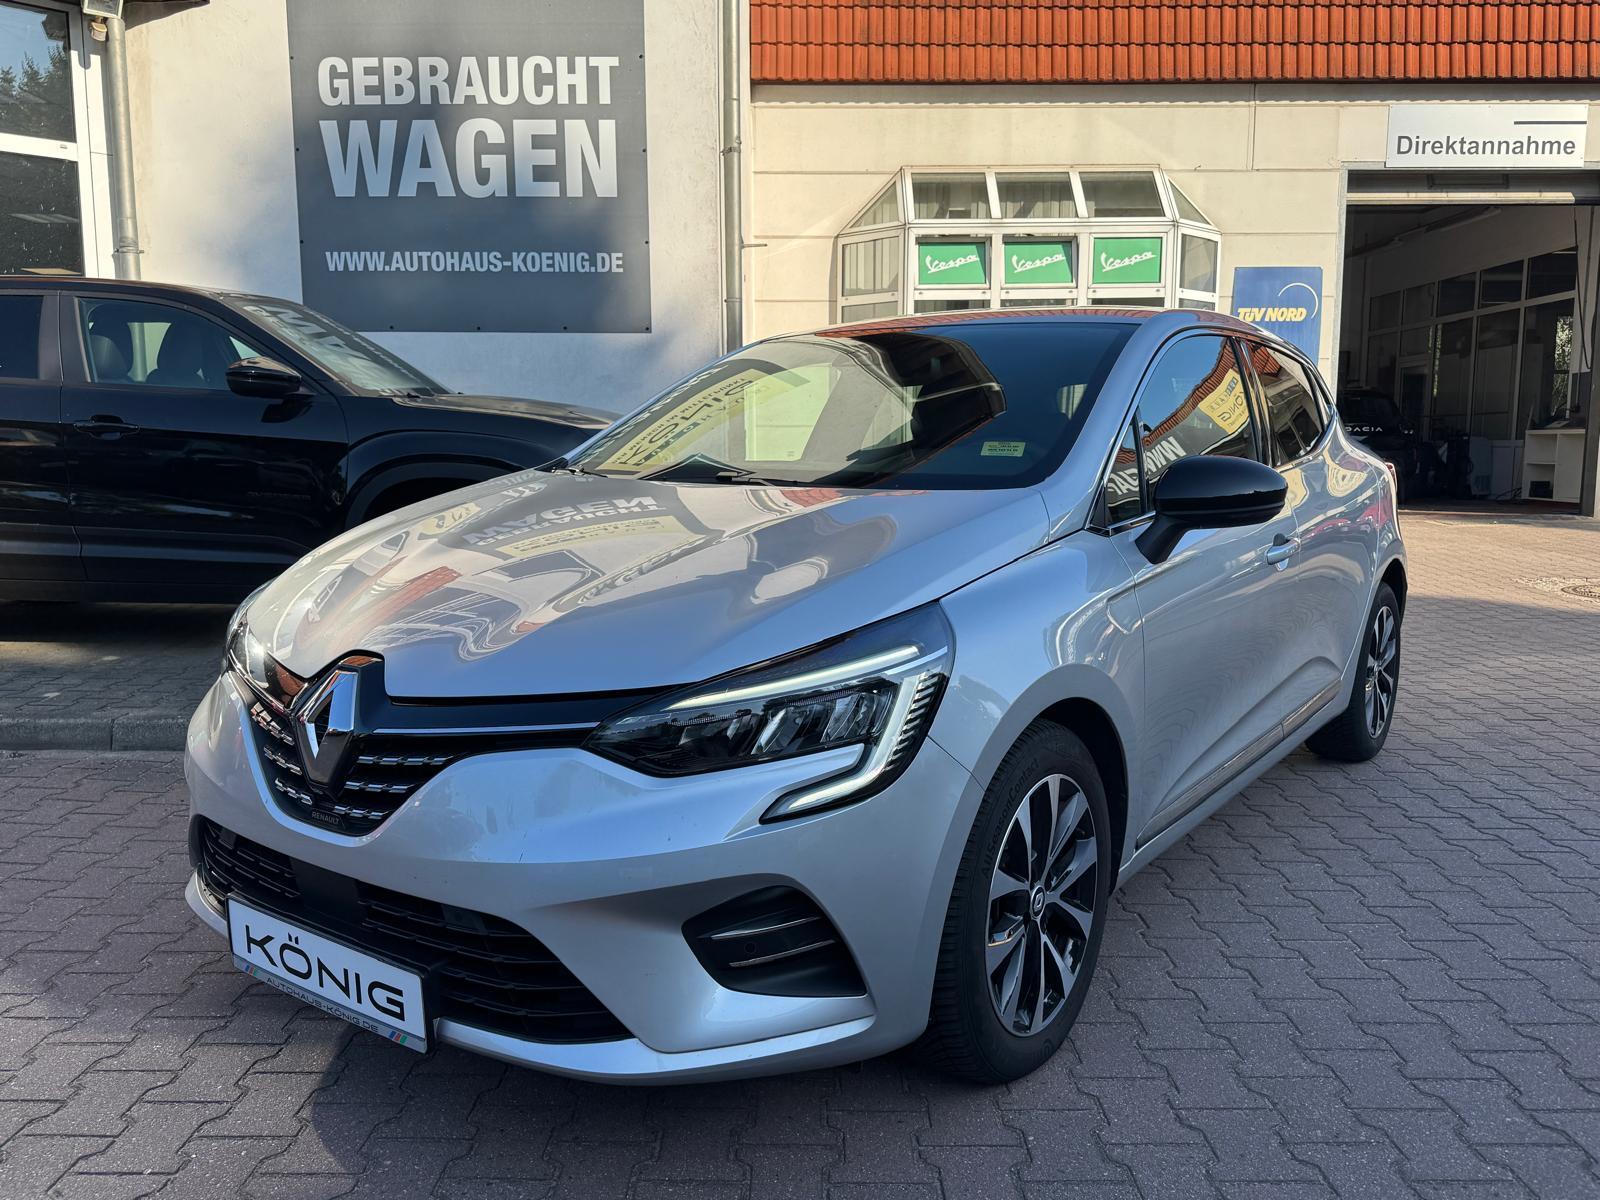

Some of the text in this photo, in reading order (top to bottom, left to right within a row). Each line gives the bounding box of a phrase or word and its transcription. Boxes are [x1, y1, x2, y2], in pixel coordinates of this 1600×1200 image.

[317, 55, 620, 106] GEBRAUCHT
[1397, 135, 1576, 156] Direktannahme
[318, 117, 619, 199] WAGEN
[324, 250, 625, 273] WWW.AUTOHAUS-KOENIG.DE
[925, 253, 980, 274] Vespa
[1012, 253, 1066, 273] Vespa
[1100, 251, 1157, 273] Vespa
[1237, 307, 1307, 322] TÜV NORD
[311, 810, 340, 825] RENAULT
[244, 923, 407, 1022] KÖNIG
[265, 976, 380, 1033] AUTOHAUS-KÖNIG.DE
